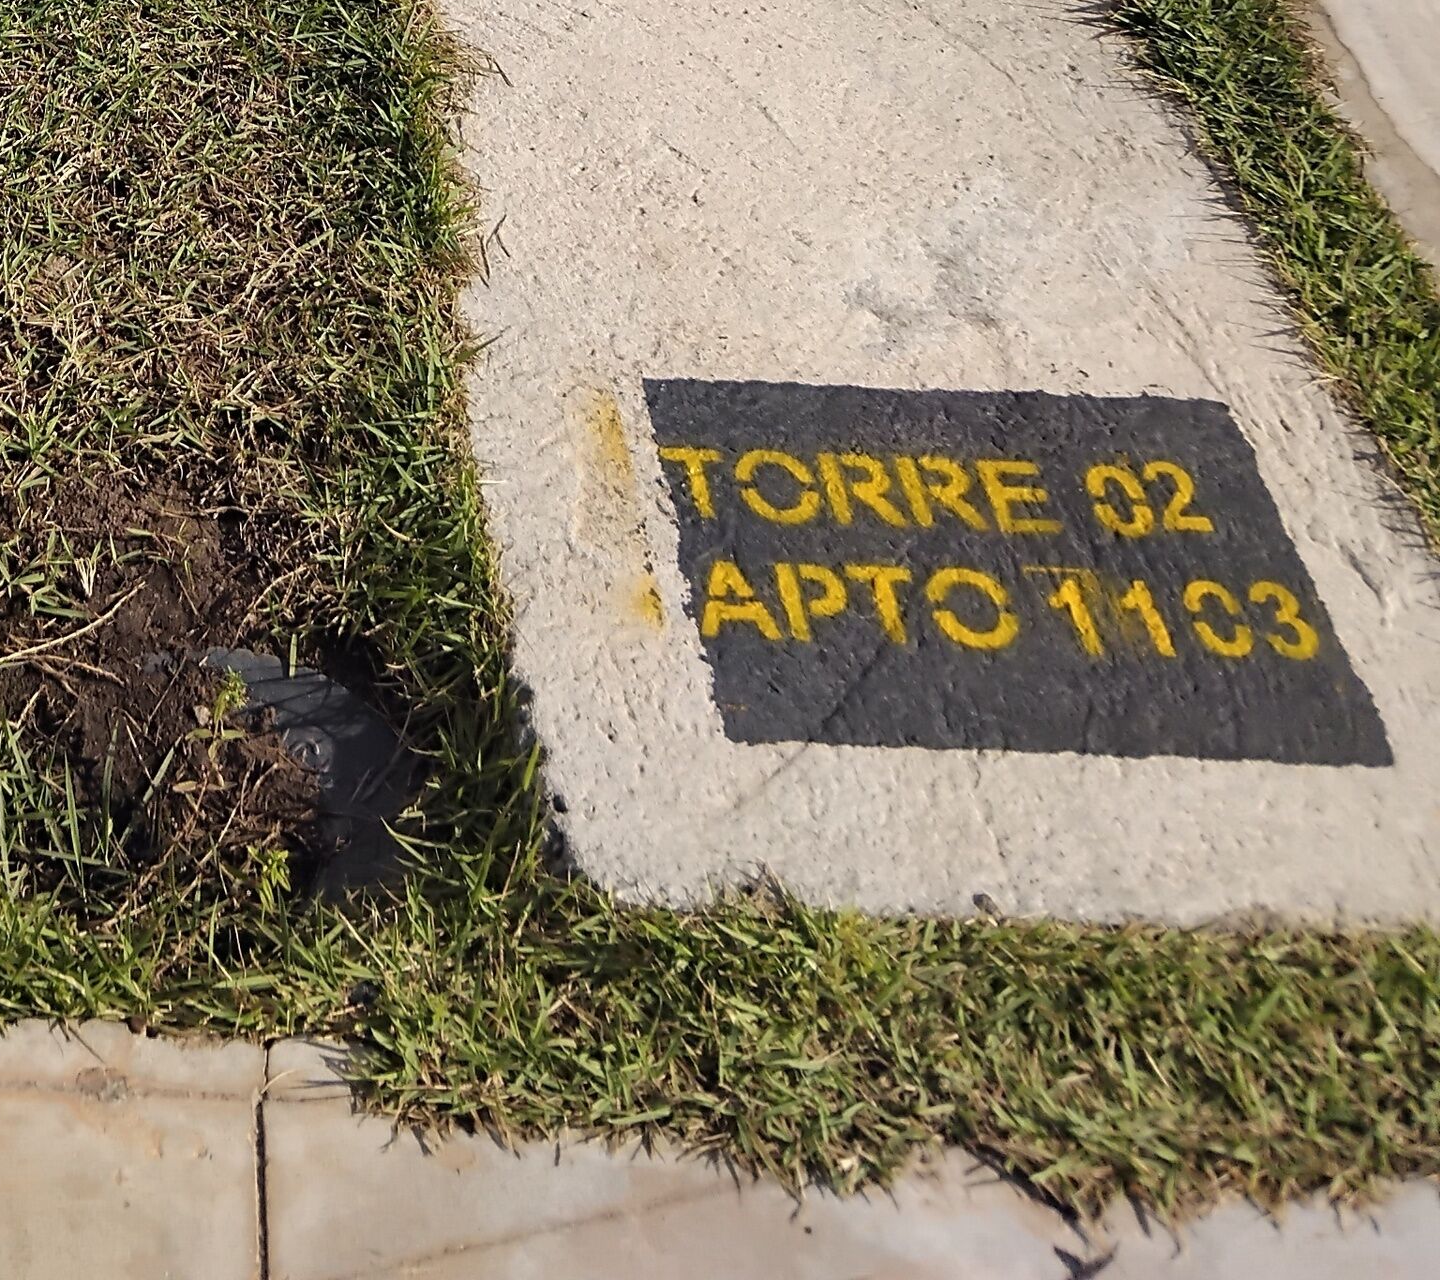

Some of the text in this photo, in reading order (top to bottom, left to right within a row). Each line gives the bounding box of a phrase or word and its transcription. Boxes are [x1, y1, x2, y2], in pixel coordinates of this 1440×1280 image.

[661, 446, 1215, 538] TORRE 02
[699, 559, 1320, 661] APTO 1103
